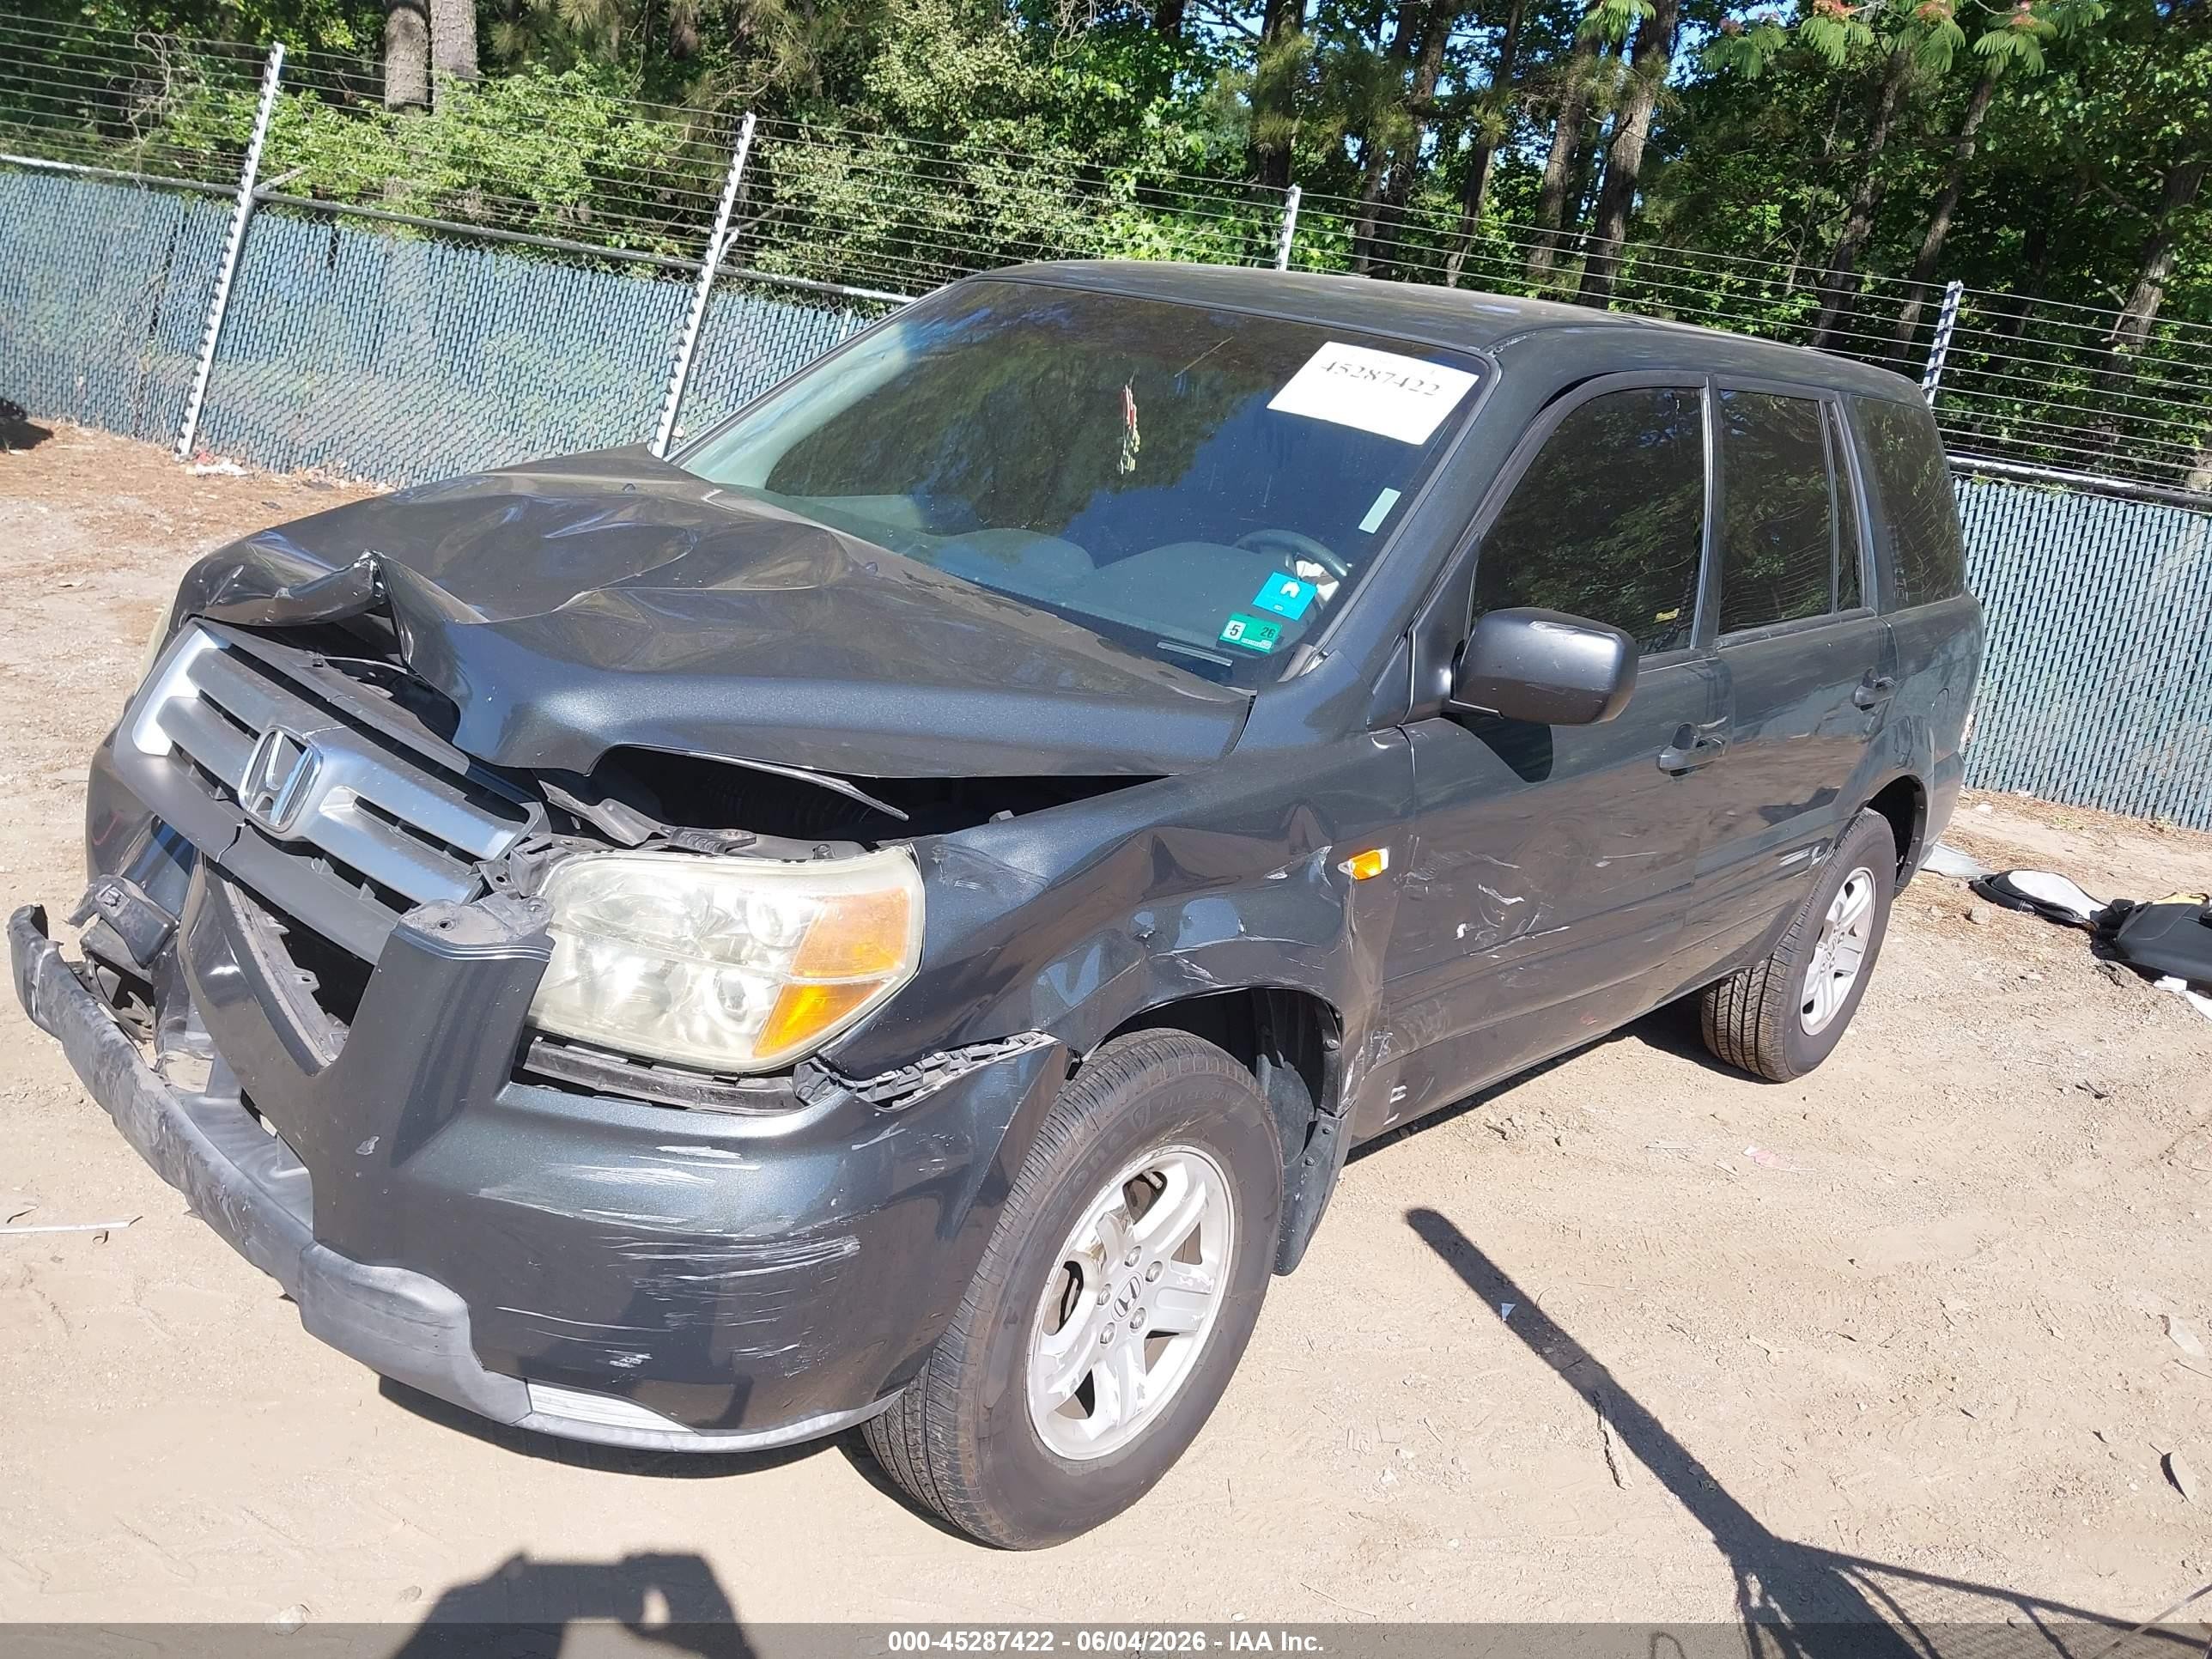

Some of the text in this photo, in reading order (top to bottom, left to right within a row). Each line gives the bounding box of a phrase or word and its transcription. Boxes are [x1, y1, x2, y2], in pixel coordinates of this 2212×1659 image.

[1321, 361, 1441, 396] 45287422
[1229, 624, 1276, 639] 5 26
